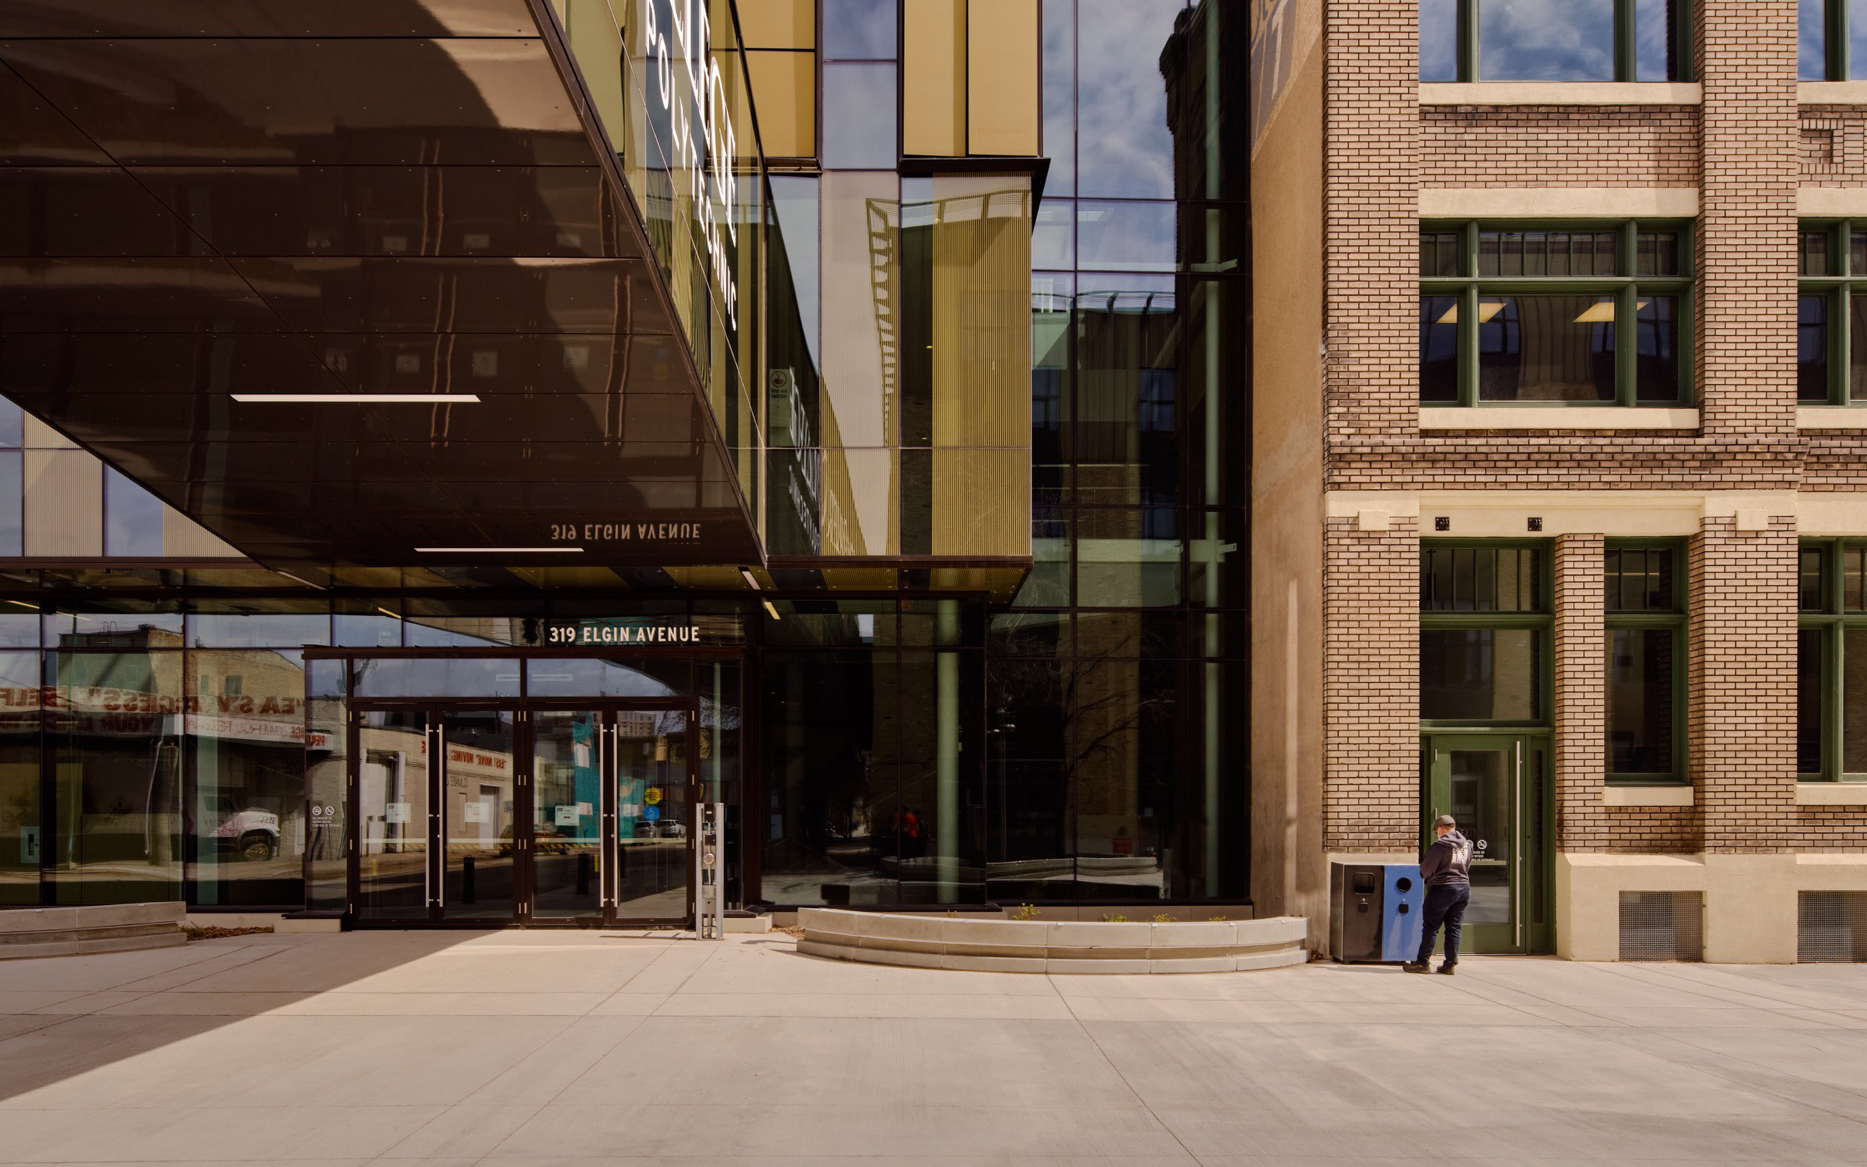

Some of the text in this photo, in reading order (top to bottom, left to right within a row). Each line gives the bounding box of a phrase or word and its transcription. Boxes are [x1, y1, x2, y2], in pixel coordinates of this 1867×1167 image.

[549, 626, 700, 643] 319 ELGIN AVENUE
